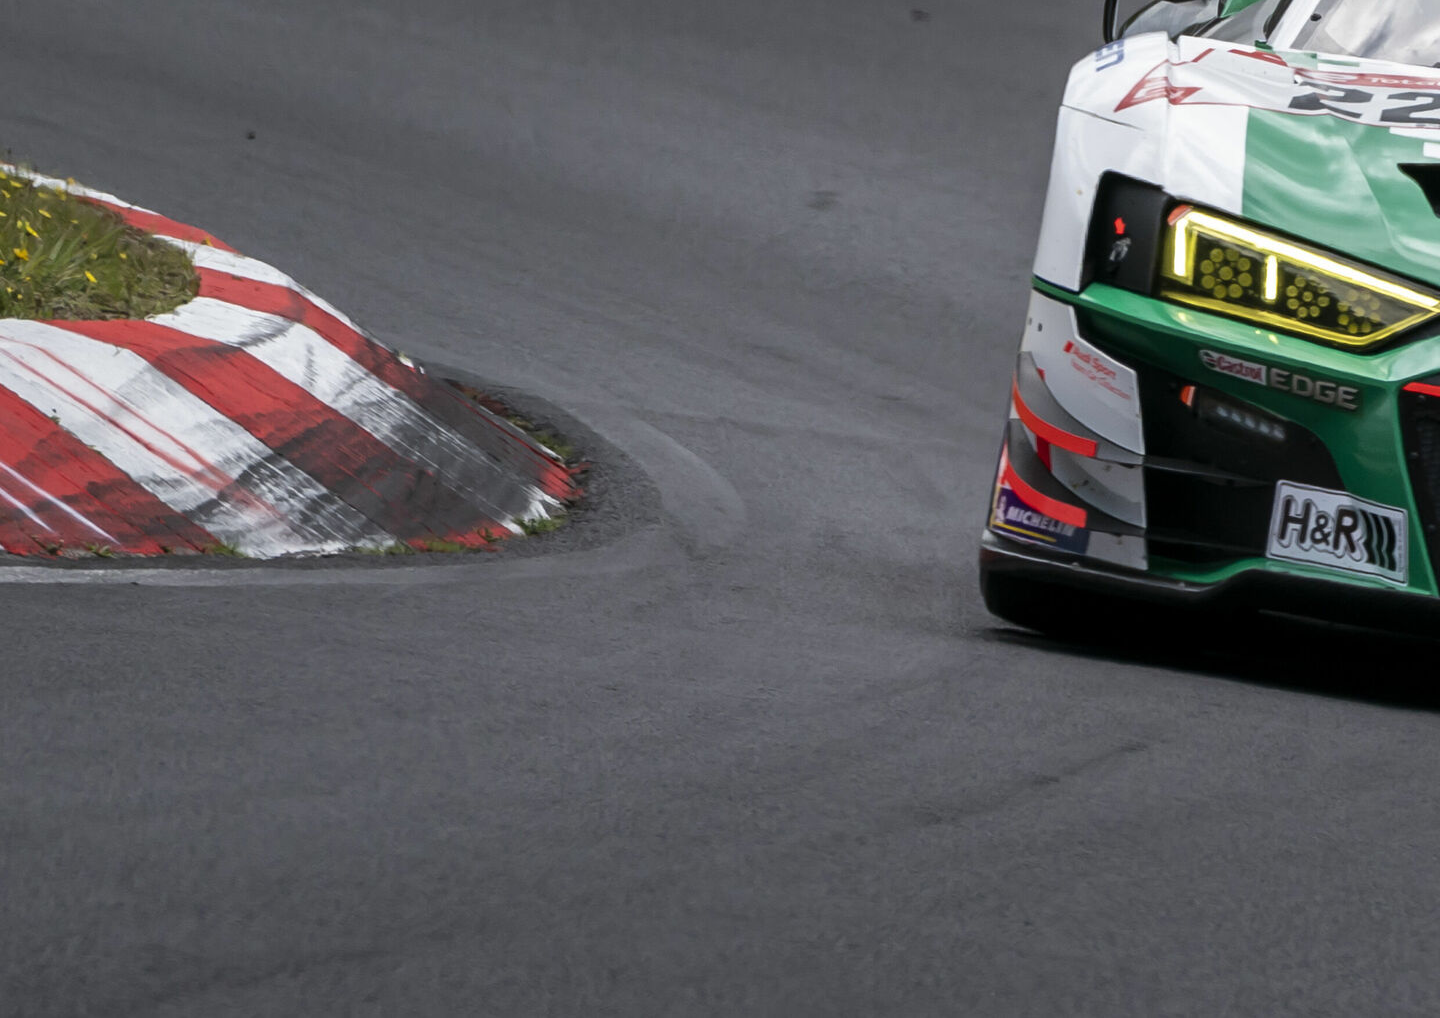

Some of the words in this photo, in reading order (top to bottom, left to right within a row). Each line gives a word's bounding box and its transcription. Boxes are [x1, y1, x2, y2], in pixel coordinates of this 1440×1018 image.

[1216, 355, 1264, 382] Castrol
[1269, 366, 1360, 411] EDGE
[1278, 494, 1360, 554] H&R
